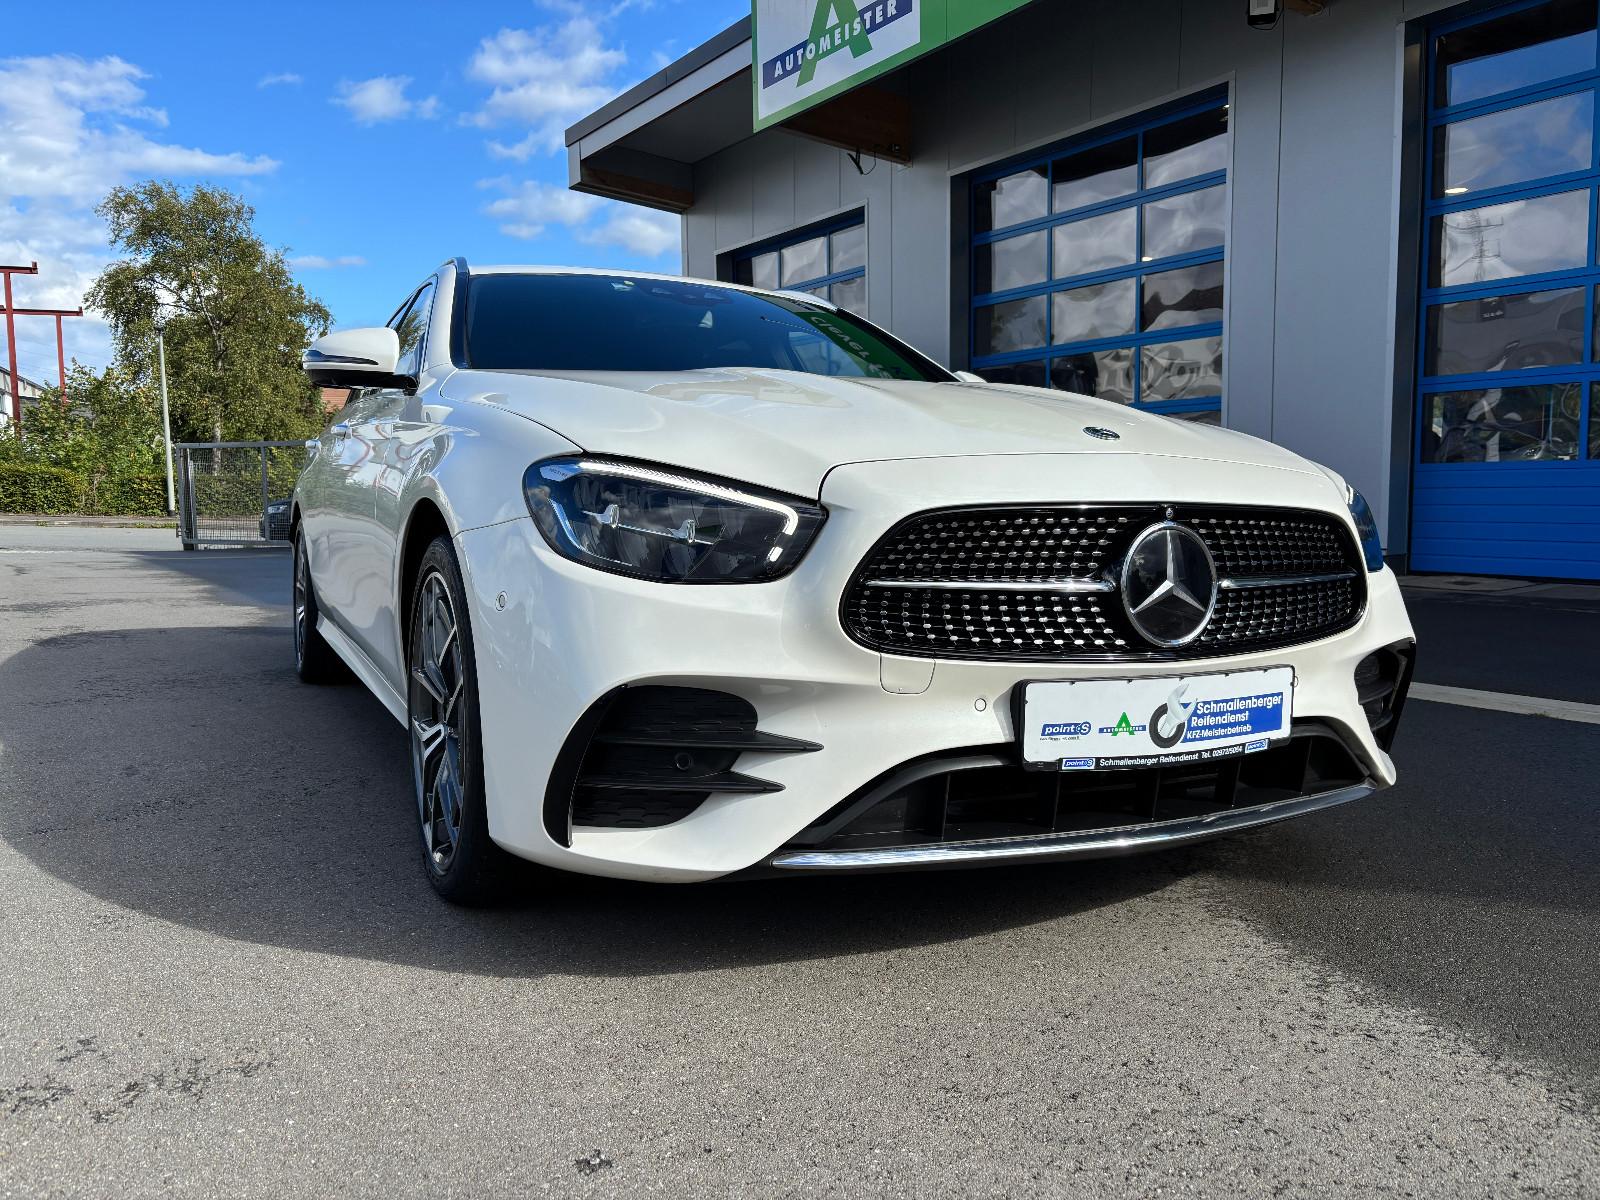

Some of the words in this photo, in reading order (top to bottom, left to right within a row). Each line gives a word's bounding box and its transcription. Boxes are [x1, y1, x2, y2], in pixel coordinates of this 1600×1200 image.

[774, 0, 897, 78] AUTOMEISTER
[1197, 694, 1282, 714] Schmallenberger
[1191, 711, 1249, 727] Reifendienst
[1187, 724, 1252, 739] KFZ-Meisterbetrieb
[1099, 756, 1158, 767] Schmallenberger
[1159, 753, 1198, 765] Reifendienst
